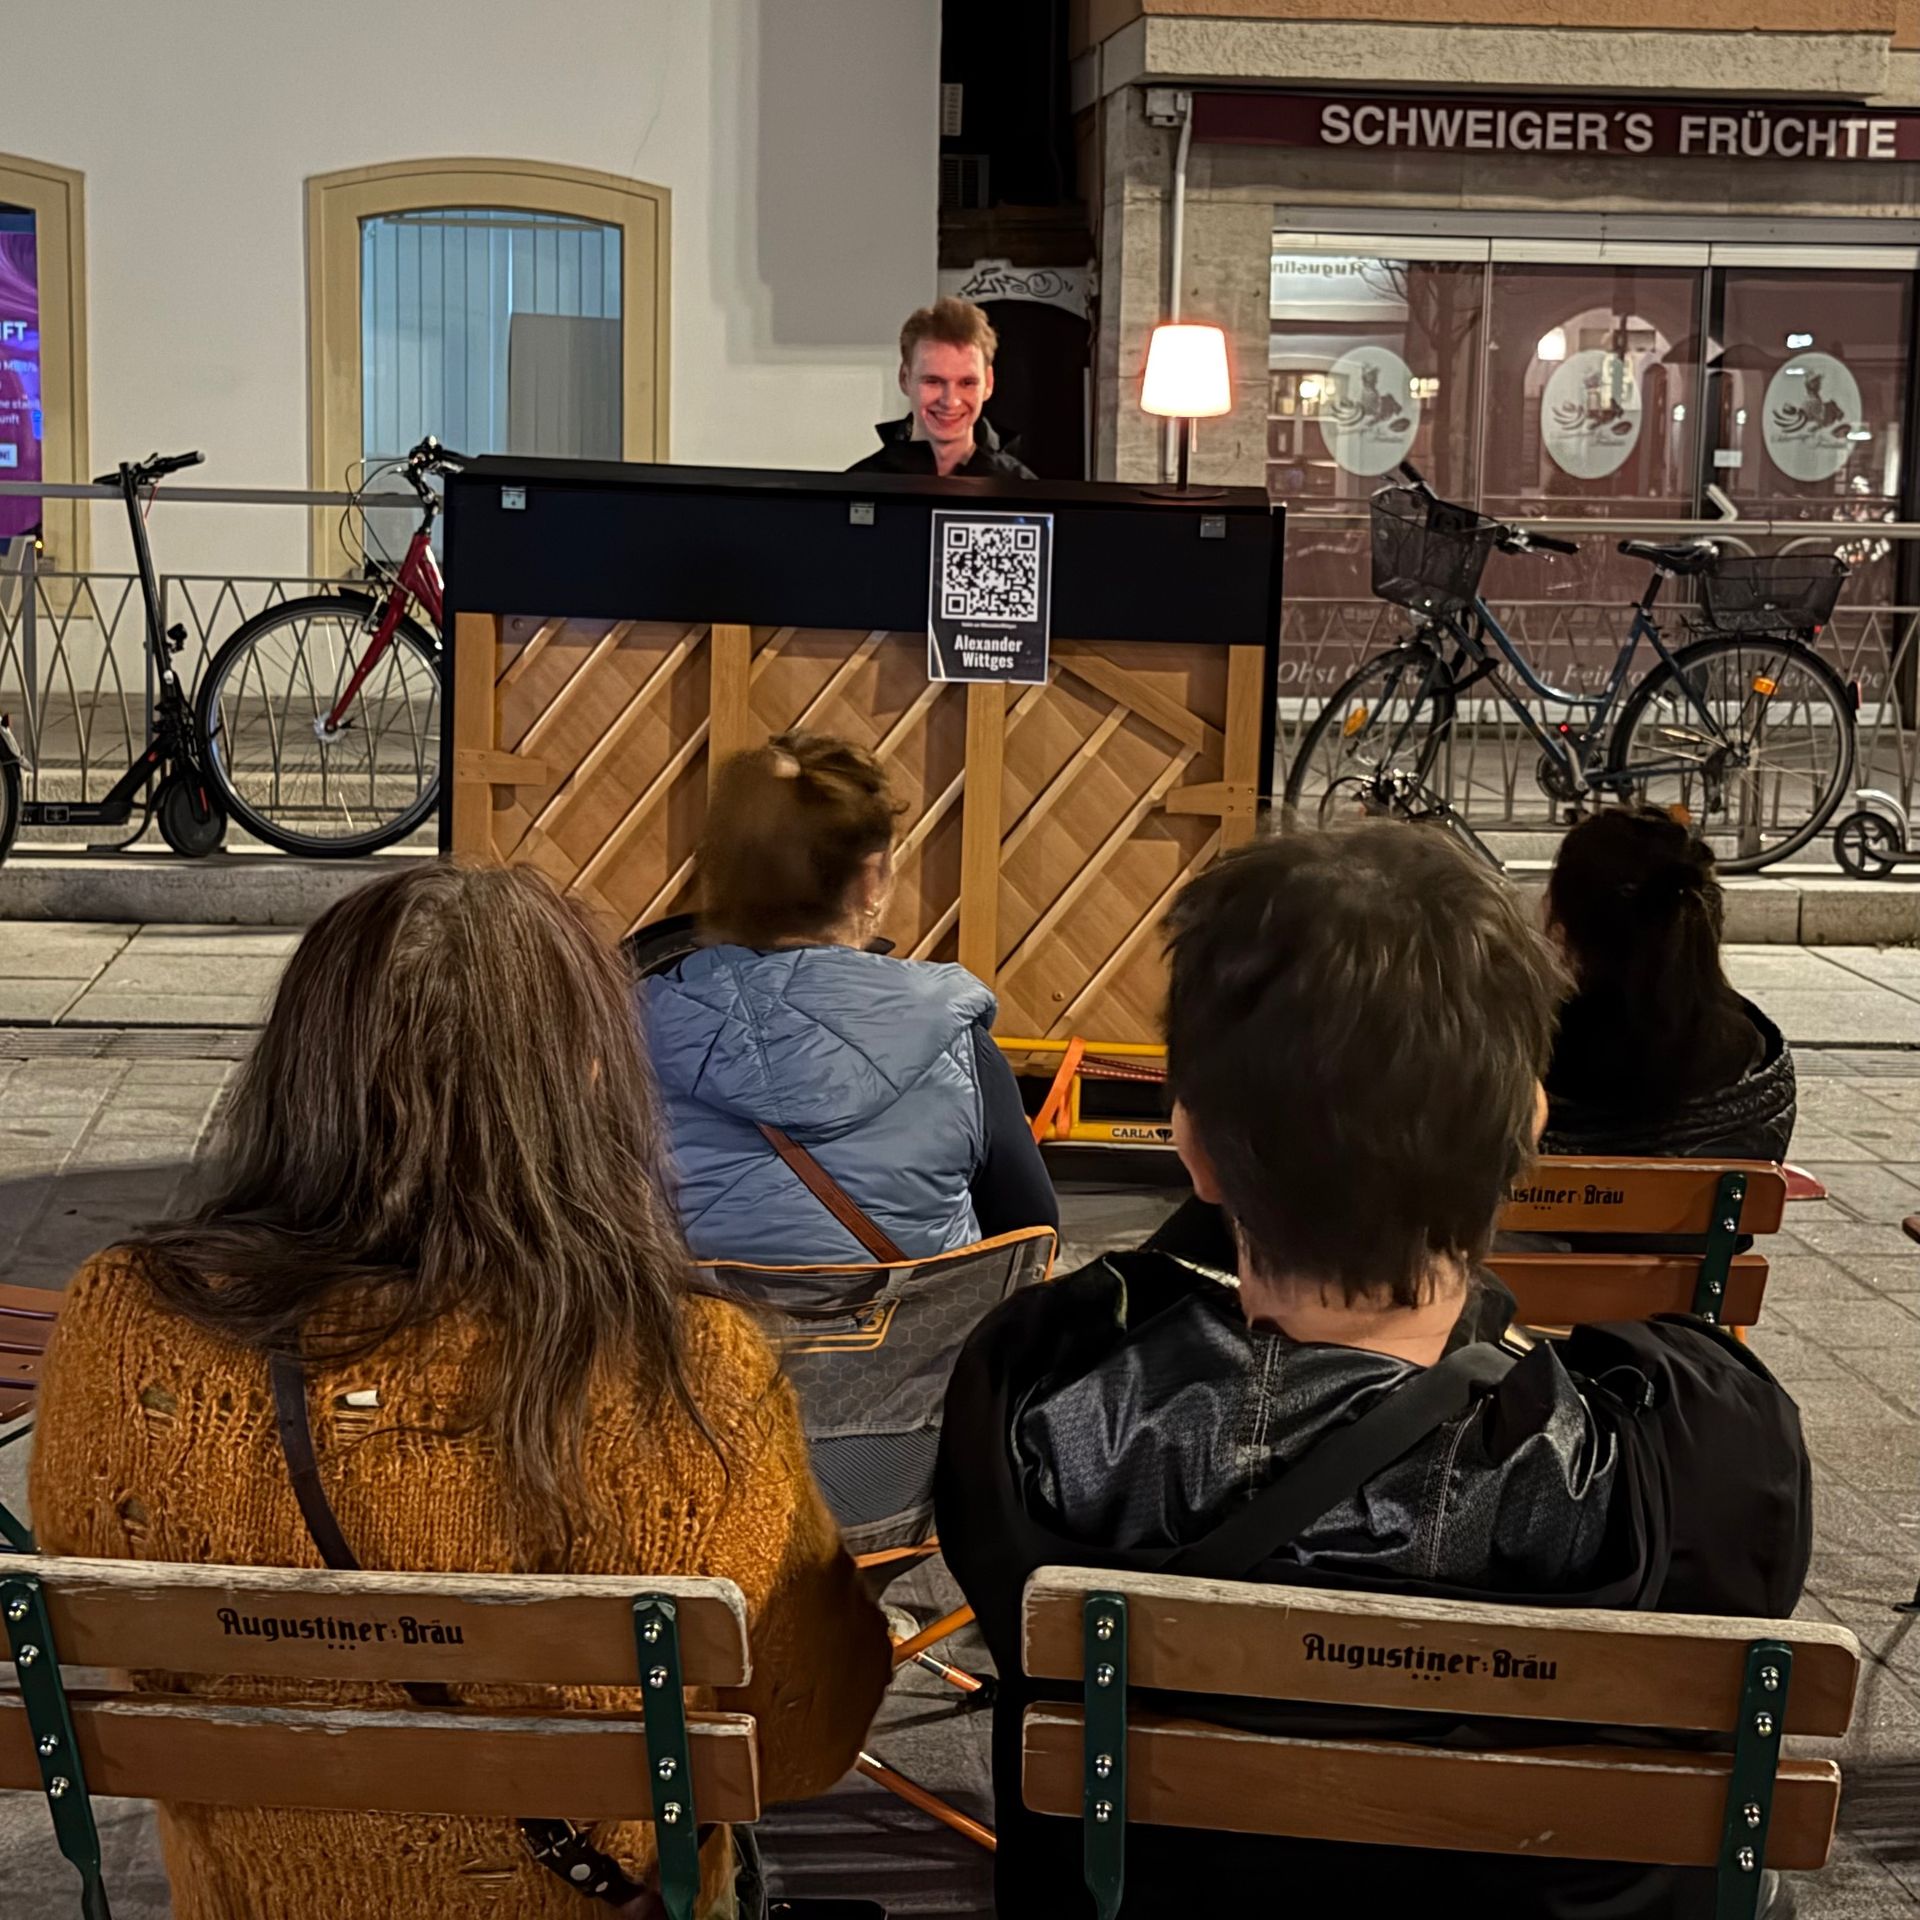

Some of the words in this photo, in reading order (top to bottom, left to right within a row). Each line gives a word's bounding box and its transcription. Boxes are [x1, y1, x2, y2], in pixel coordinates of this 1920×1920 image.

[1678, 110, 1897, 159] FRÜCHTE
[954, 634, 1023, 653] Alexander
[962, 652, 1015, 671] Wittges
[1277, 661, 1338, 684] Obst
[1111, 1127, 1155, 1139] CARLA
